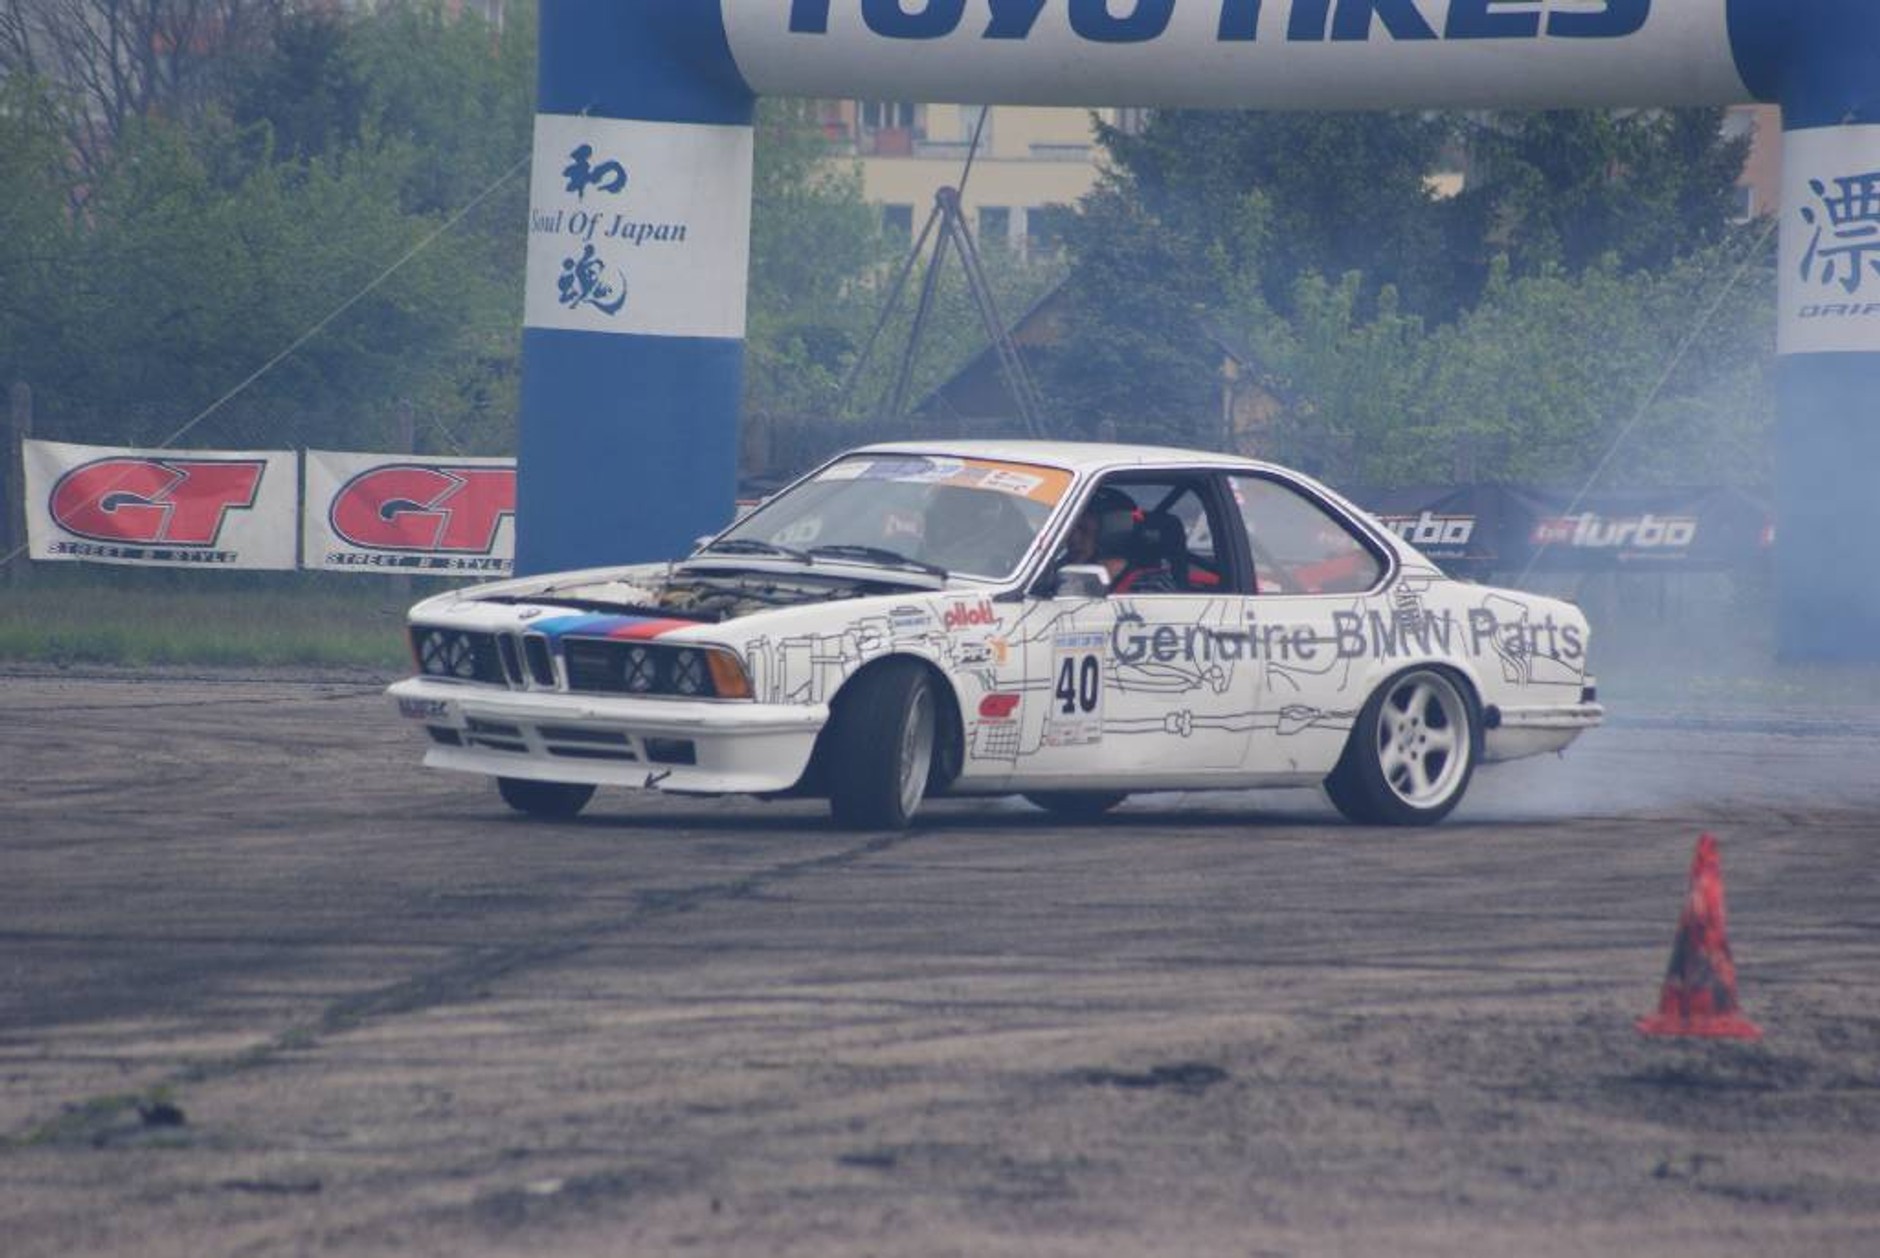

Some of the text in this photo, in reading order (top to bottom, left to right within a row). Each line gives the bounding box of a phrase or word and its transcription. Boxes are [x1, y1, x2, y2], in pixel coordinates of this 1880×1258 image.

[568, 211, 604, 242] Of
[604, 214, 687, 246] Japan
[48, 456, 267, 547] GT
[325, 552, 401, 567] STREET
[1111, 608, 1583, 664] Genuine BMW Parts
[1055, 655, 1099, 713] 40
